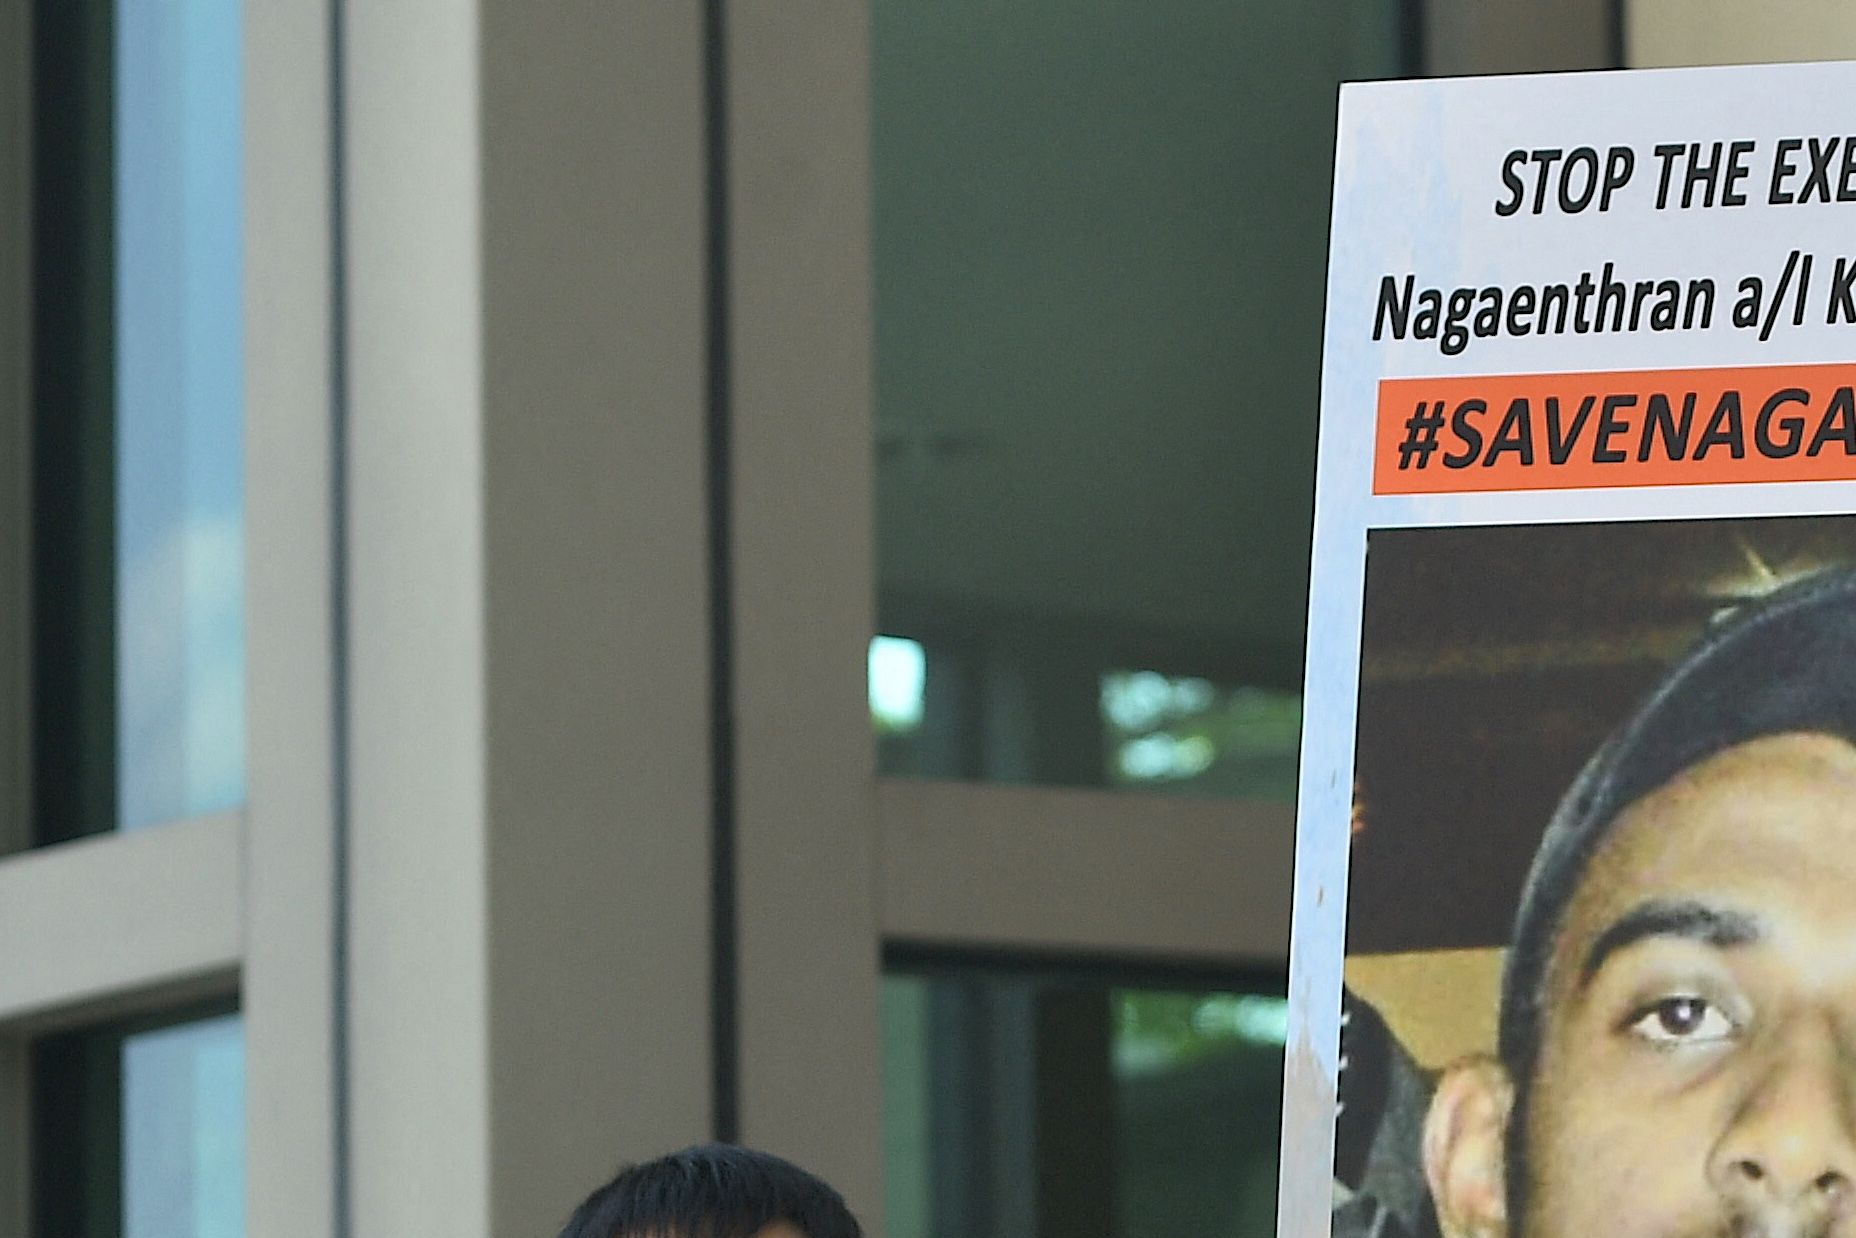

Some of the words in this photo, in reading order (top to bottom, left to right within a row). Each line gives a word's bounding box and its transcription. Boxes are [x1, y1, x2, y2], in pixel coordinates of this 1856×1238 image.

[1496, 147, 1634, 216] STOP
[1654, 141, 1755, 209] THE
[1373, 263, 1714, 355] Nagaenthran
